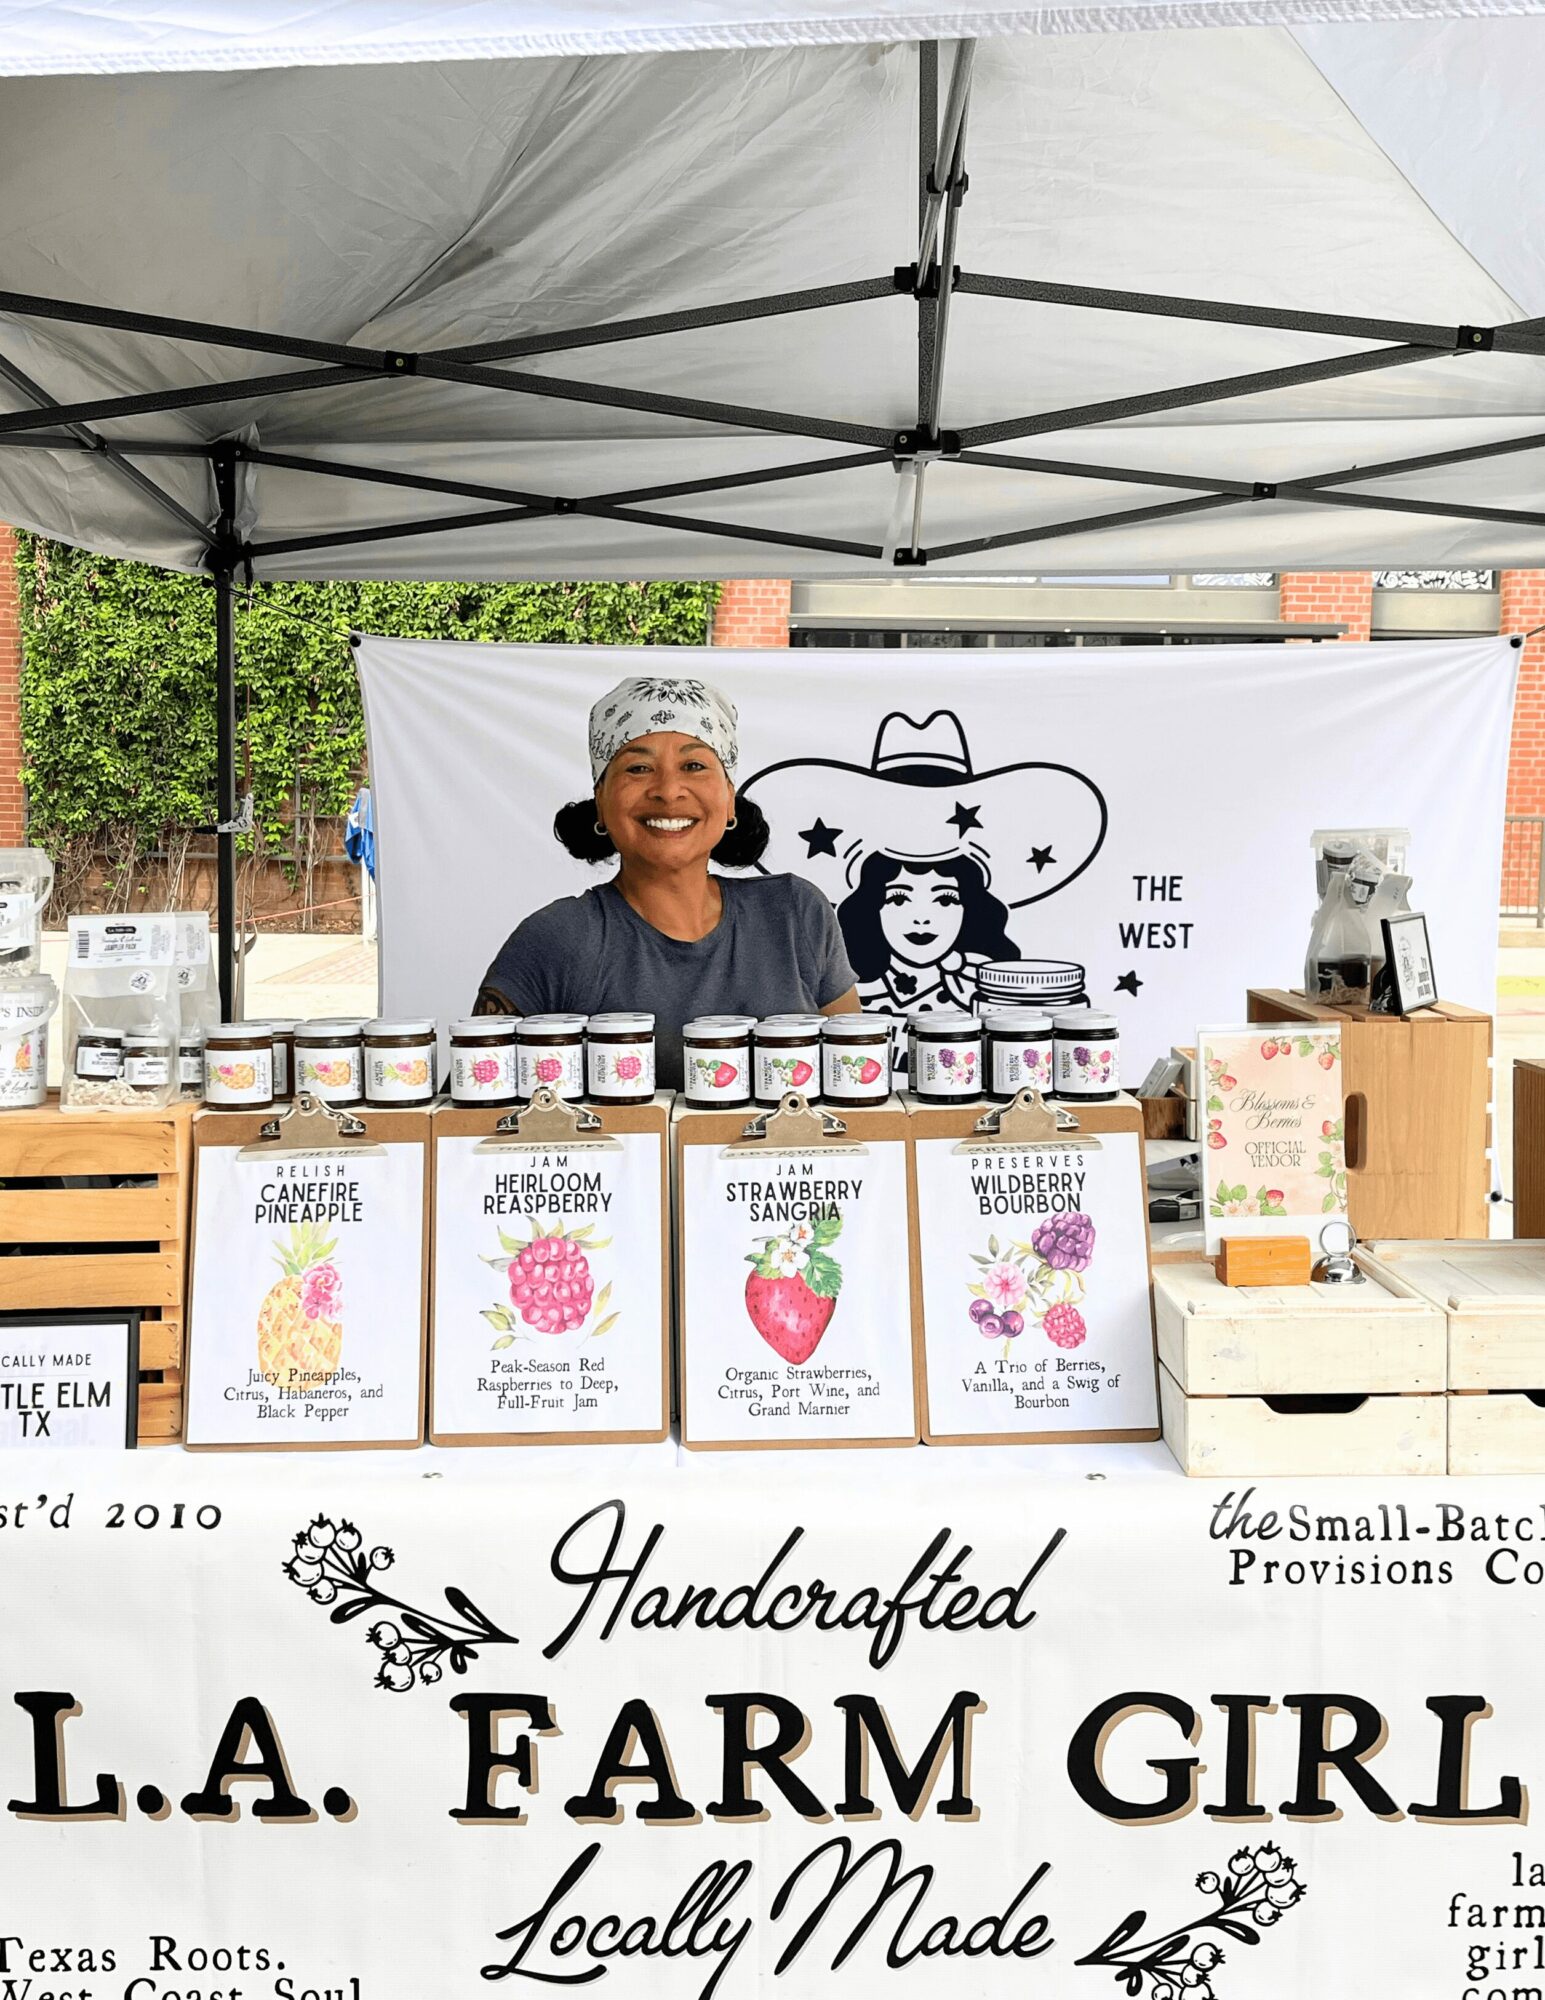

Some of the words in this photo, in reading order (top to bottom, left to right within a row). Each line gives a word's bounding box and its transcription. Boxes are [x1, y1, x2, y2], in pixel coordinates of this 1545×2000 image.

[1132, 875, 1183, 901] THE
[1118, 922, 1194, 949] WEST
[1230, 1088, 1300, 1112] Blossoms
[1301, 1094, 1316, 1110] &
[1246, 1110, 1302, 1130] Berries
[1244, 1140, 1306, 1155] OFFICIAL
[530, 1156, 568, 1167] JAM
[776, 1164, 813, 1176] JAM
[971, 1155, 1084, 1170] PRESERVES
[1250, 1154, 1301, 1167] VENDOR
[277, 1165, 345, 1178] RELISH
[261, 1182, 359, 1203] CANEFIRE
[495, 1172, 601, 1193] HEIRLOOM
[726, 1180, 863, 1202] STRAWBERRY
[971, 1172, 1086, 1195] WILDBERRY
[255, 1203, 363, 1223] PINEAPPLE
[484, 1193, 612, 1214] REASPBERRY
[750, 1201, 841, 1222] SANGRIA
[979, 1193, 1081, 1215] BOURBON
[1, 1354, 45, 1367] CALLY
[53, 1354, 92, 1366] MADE
[491, 1359, 570, 1373] Peak-Season
[579, 1357, 605, 1372] Red
[974, 1361, 987, 1374] A
[995, 1360, 1027, 1373] Trio
[1035, 1359, 1048, 1372] of
[1056, 1358, 1106, 1373] Berries,
[246, 1368, 280, 1386] Juicy
[288, 1368, 362, 1386] Pineapples,
[725, 1367, 779, 1385] Organic
[786, 1365, 872, 1381] Strawberries,
[962, 1378, 1014, 1393] Vanilla,
[1022, 1376, 1044, 1390] and
[1052, 1380, 1059, 1389] a
[1067, 1376, 1099, 1393] Swig
[1107, 1374, 1121, 1388] of
[0, 1382, 45, 1410] TLE
[58, 1381, 111, 1408] ELM
[224, 1386, 269, 1403] Citrus,
[278, 1386, 352, 1401] Habaneros,
[360, 1384, 384, 1398] and
[477, 1377, 552, 1396] Raspberries
[560, 1380, 573, 1390] to
[580, 1376, 618, 1394] Deep,
[718, 1385, 763, 1401] Citrus,
[771, 1384, 800, 1398] Port
[809, 1383, 849, 1399] Wine,
[857, 1382, 880, 1397] and
[497, 1395, 565, 1409] Full-Fruit
[572, 1393, 598, 1412] Jam
[748, 1402, 790, 1416] Grand
[799, 1402, 850, 1415] Marnier
[1014, 1394, 1069, 1409] Bourbon
[257, 1404, 296, 1419] Black
[304, 1404, 349, 1422] Pepper
[19, 1411, 51, 1437] TX
[105, 1503, 222, 1530] 2010
[1209, 1486, 1283, 1540] the
[1228, 1548, 1453, 1584] Provisions
[1486, 1548, 1544, 1584] Co
[542, 1500, 1067, 1670] Handcrafted
[7, 1690, 357, 1822] L.A.
[448, 1690, 987, 1824] FARM
[1067, 1691, 1528, 1825] GIRL
[480, 1842, 753, 2000] Locally
[769, 1836, 1055, 1976] Made
[1448, 1892, 1545, 1928] farm
[0, 1936, 116, 1972] Texas
[149, 1936, 285, 1970] Roots.
[1466, 1935, 1545, 1981] girl
